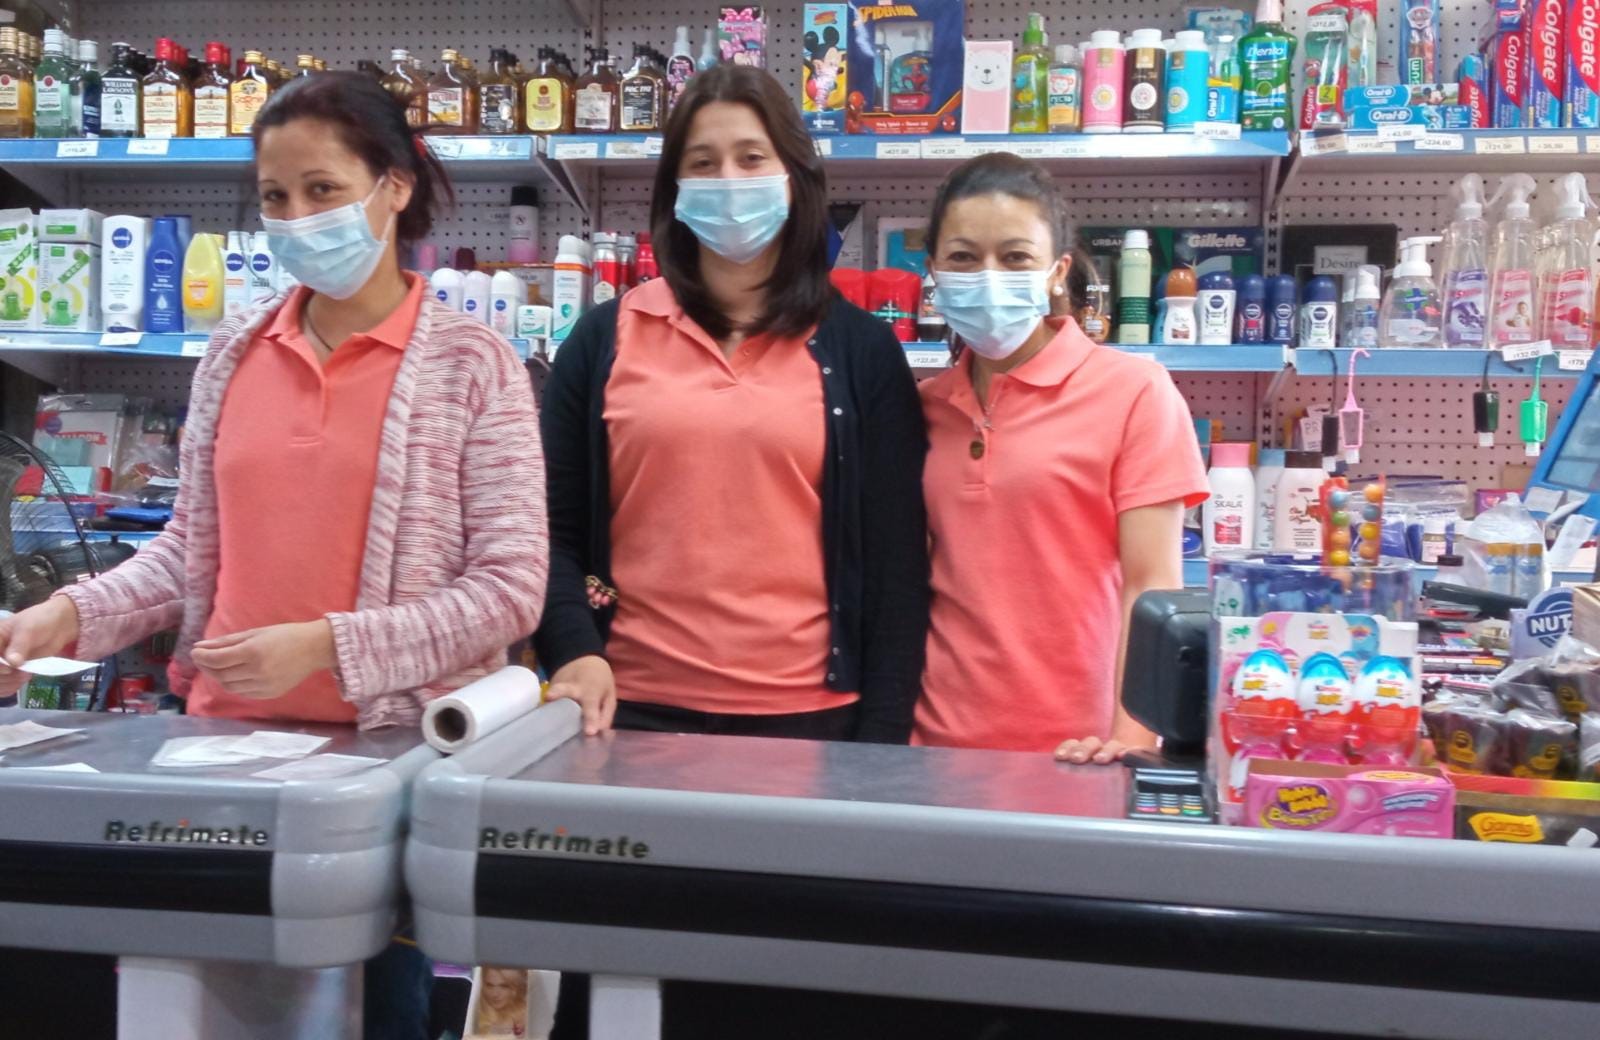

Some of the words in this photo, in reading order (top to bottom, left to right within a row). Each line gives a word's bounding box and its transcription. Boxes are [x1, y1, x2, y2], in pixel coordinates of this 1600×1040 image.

[1247, 46, 1284, 57] Dento
[1541, 0, 1562, 81] Colgate
[1504, 35, 1520, 94] Colgate
[1304, 88, 1315, 124] Colgate
[1372, 110, 1409, 121] Oral-B
[1470, 87, 1482, 128] olgate
[1188, 232, 1246, 248] Gillette
[1214, 500, 1242, 508] SKALA
[106, 819, 268, 846] Refrimate
[479, 827, 649, 859] Refrimate
